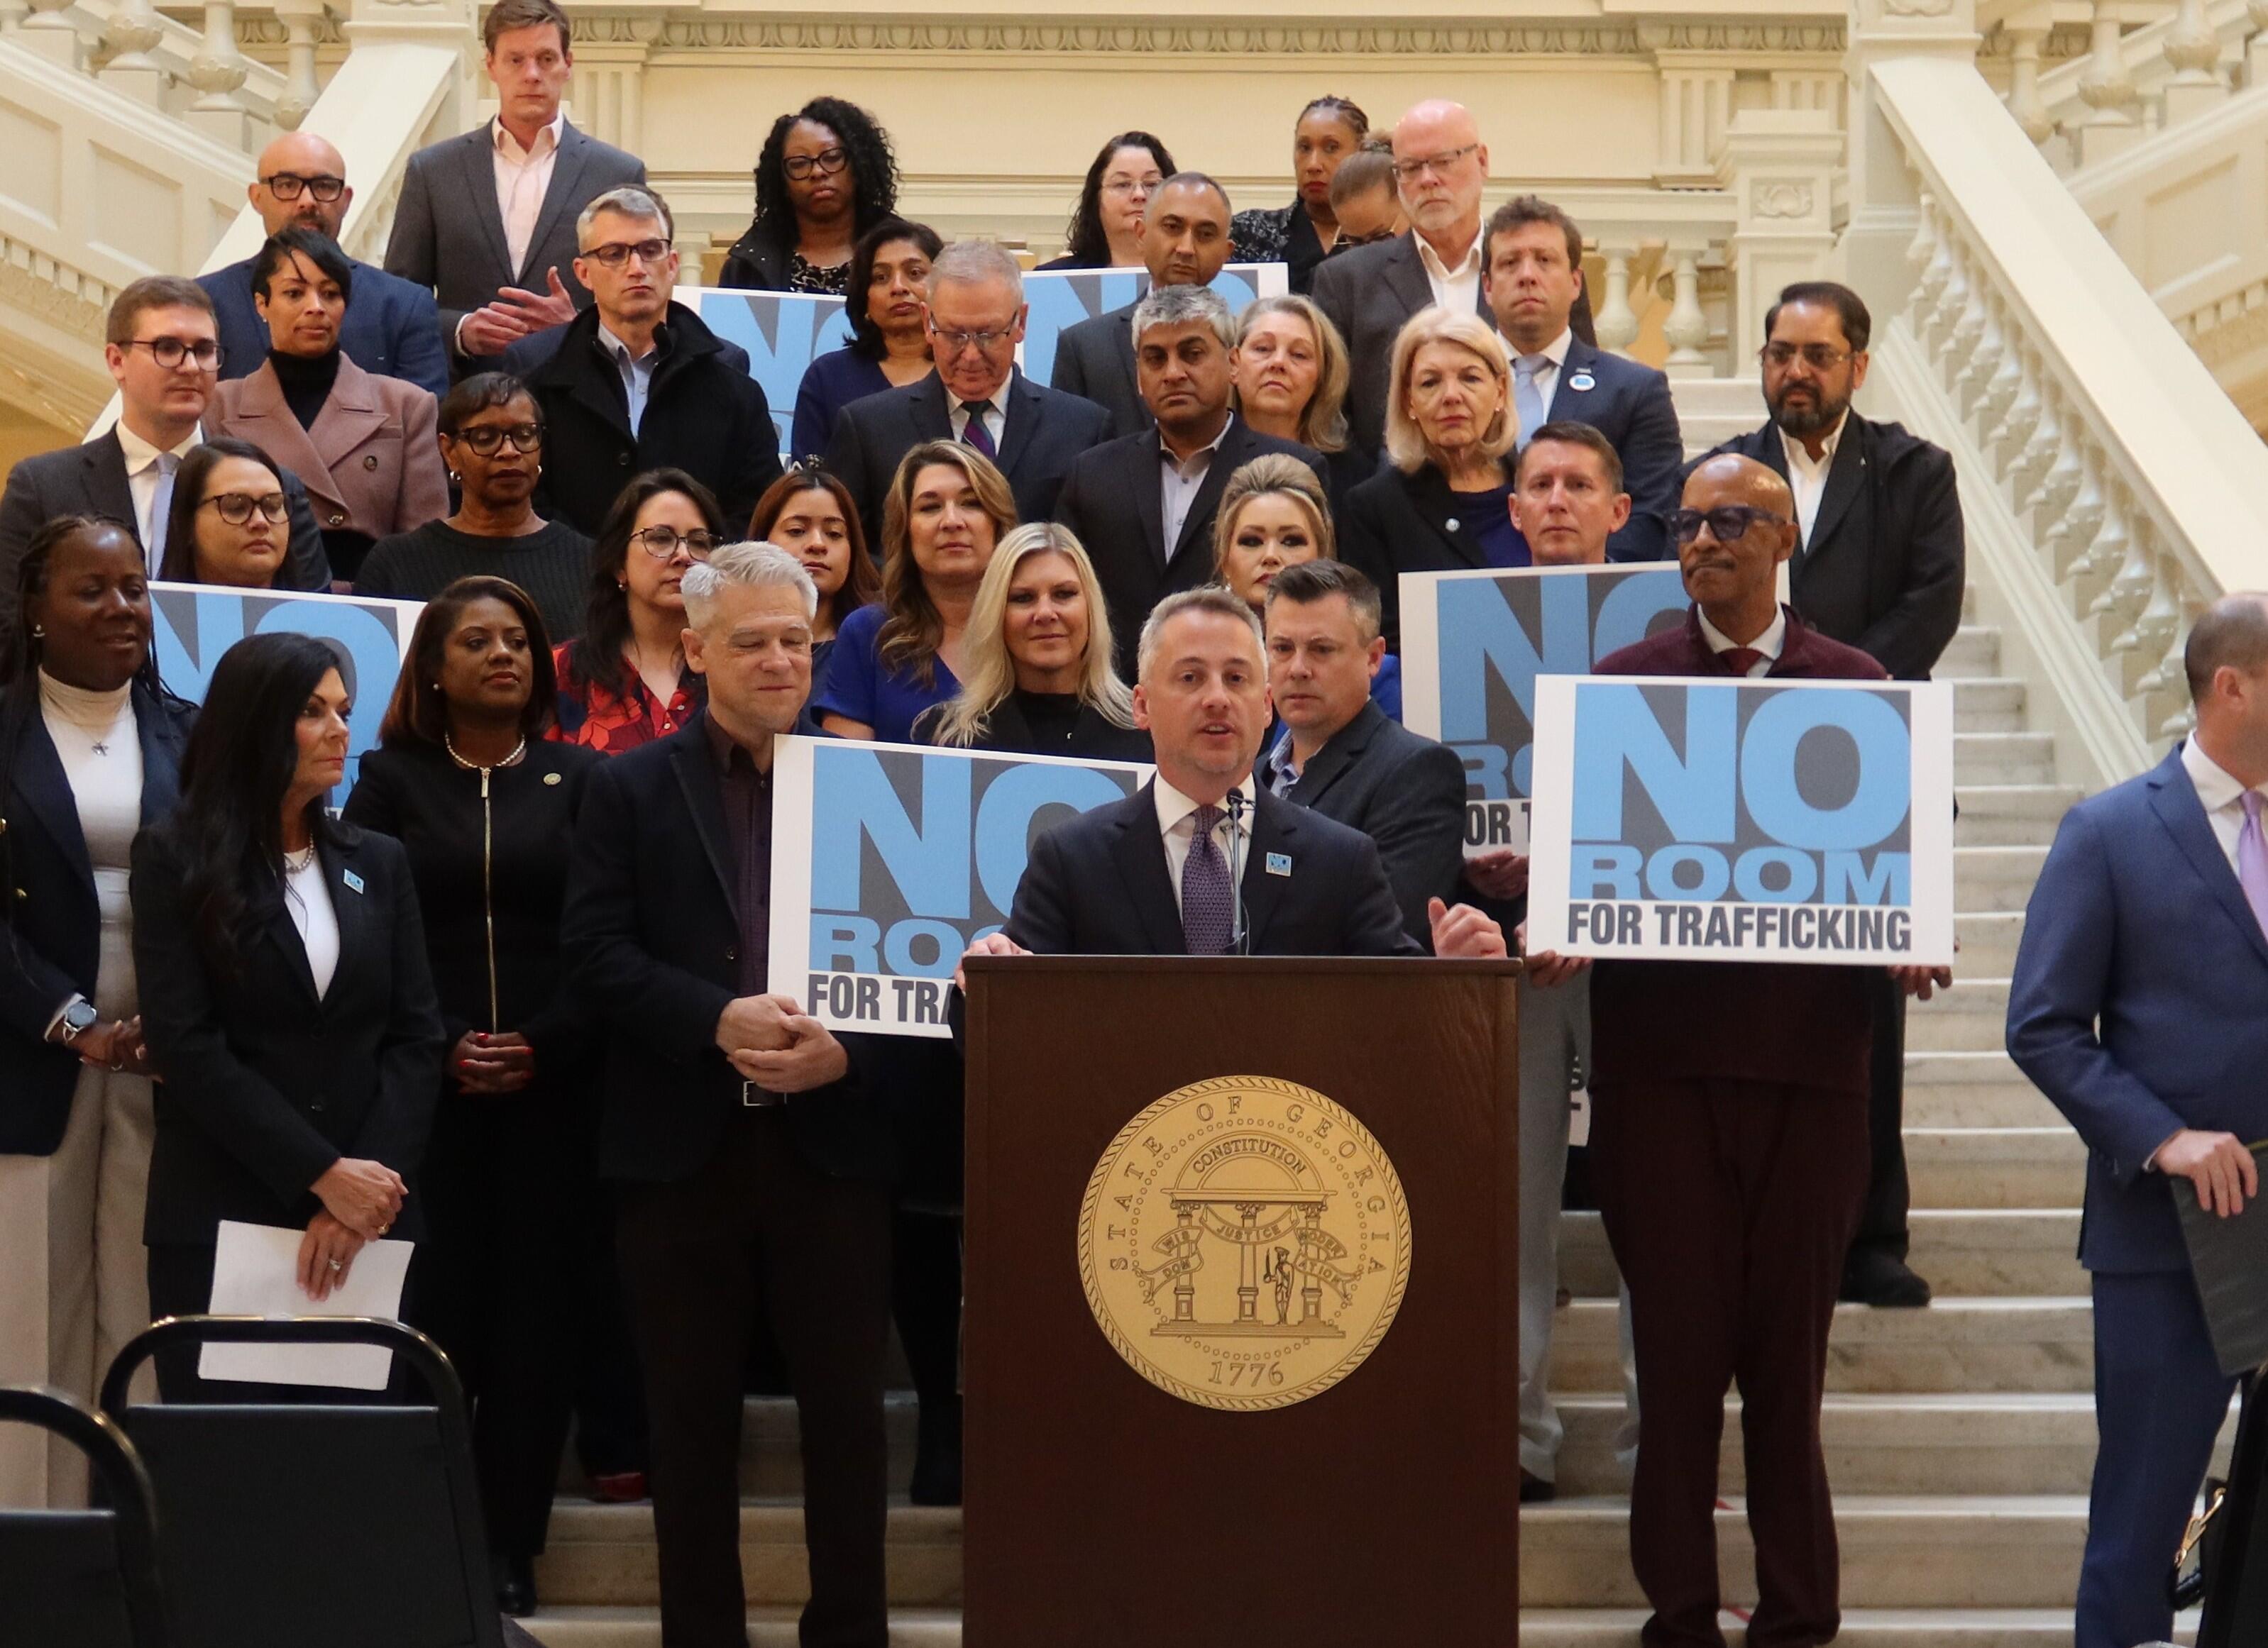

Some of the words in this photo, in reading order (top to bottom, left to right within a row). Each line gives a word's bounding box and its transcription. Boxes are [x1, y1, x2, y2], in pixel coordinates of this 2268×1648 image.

[1571, 684, 1911, 851] NO
[1465, 802, 1512, 846] OR
[1570, 844, 1911, 905] ROOM
[1568, 904, 1642, 944] FOR
[1655, 905, 1911, 951] TRAFFICKING
[808, 974, 880, 1020] FOR
[1193, 1139, 1307, 1175] CONSTITUTION
[1108, 1137, 1163, 1270] STATE
[1197, 1096, 1242, 1122] OF
[1287, 1103, 1389, 1274] GEORGIA
[1216, 1225, 1282, 1241] JUSTICE
[1208, 1362, 1284, 1387] 1776
